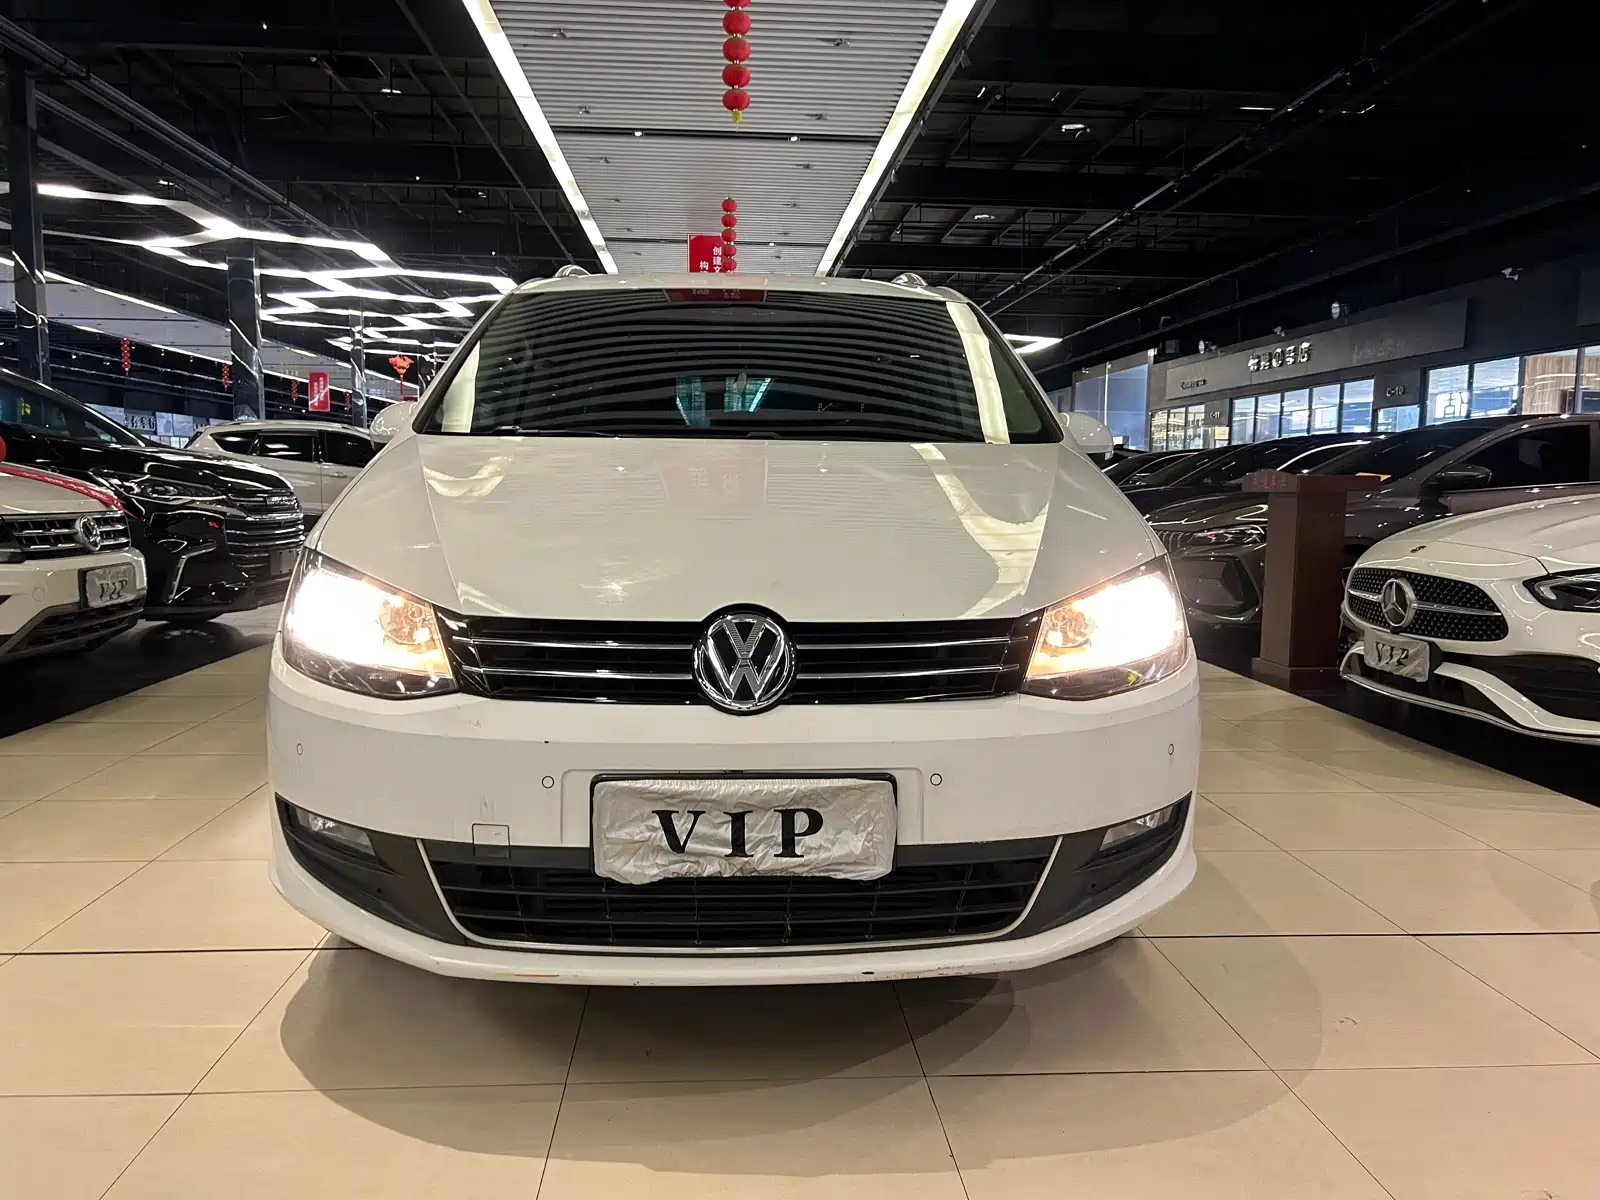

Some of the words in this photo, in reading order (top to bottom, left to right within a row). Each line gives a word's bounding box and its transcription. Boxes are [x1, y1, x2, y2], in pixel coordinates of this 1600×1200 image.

[700, 260, 709, 273] 构
[1385, 385, 1405, 398] C-10
[1374, 640, 1410, 667] VIP
[651, 807, 825, 859] VIP
